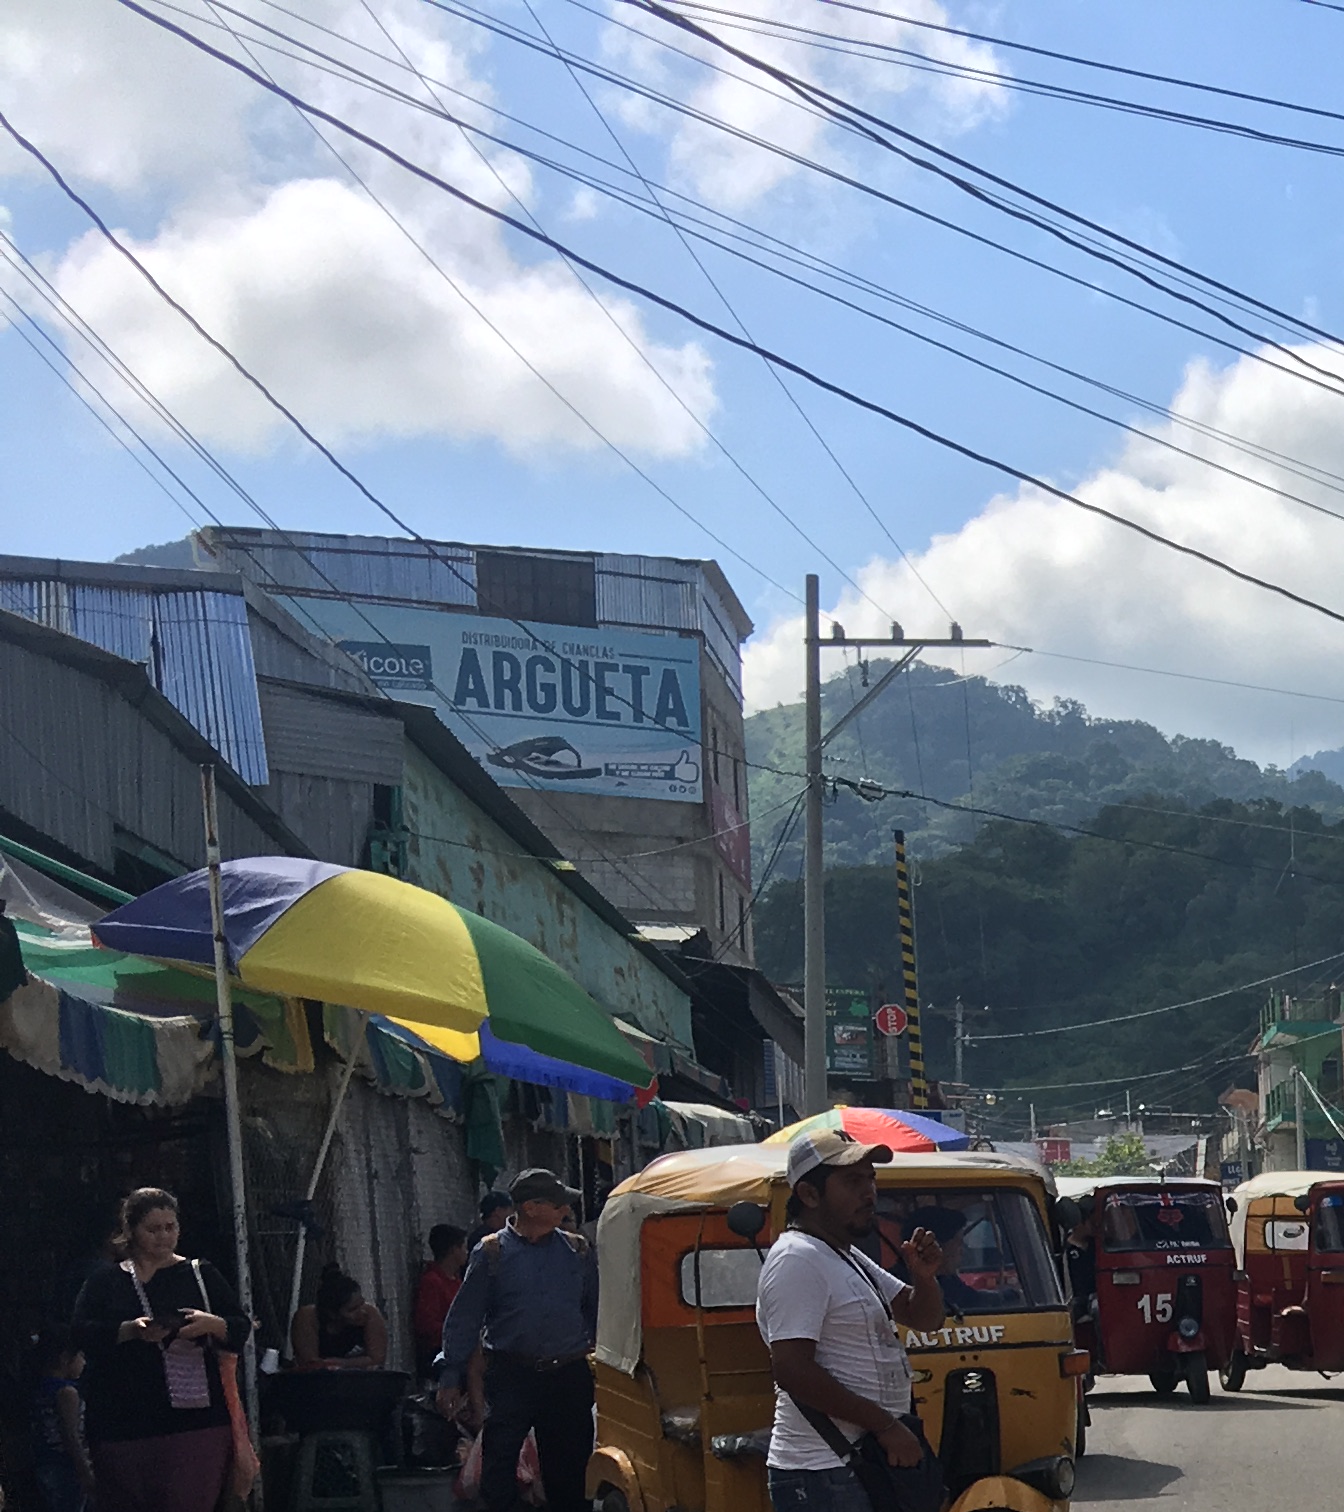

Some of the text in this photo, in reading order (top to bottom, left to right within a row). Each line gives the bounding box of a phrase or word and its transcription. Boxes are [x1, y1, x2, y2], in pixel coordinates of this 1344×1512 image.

[461, 631, 538, 652] DISTRIBUIDORA
[562, 642, 616, 659] CHANCLAS
[453, 647, 690, 729] ARGUETA
[887, 1007, 898, 1034] STOP
[1166, 1254, 1207, 1264] ACTRUF
[1137, 1293, 1173, 1324] 15
[905, 1325, 1005, 1348] ACTRUF
